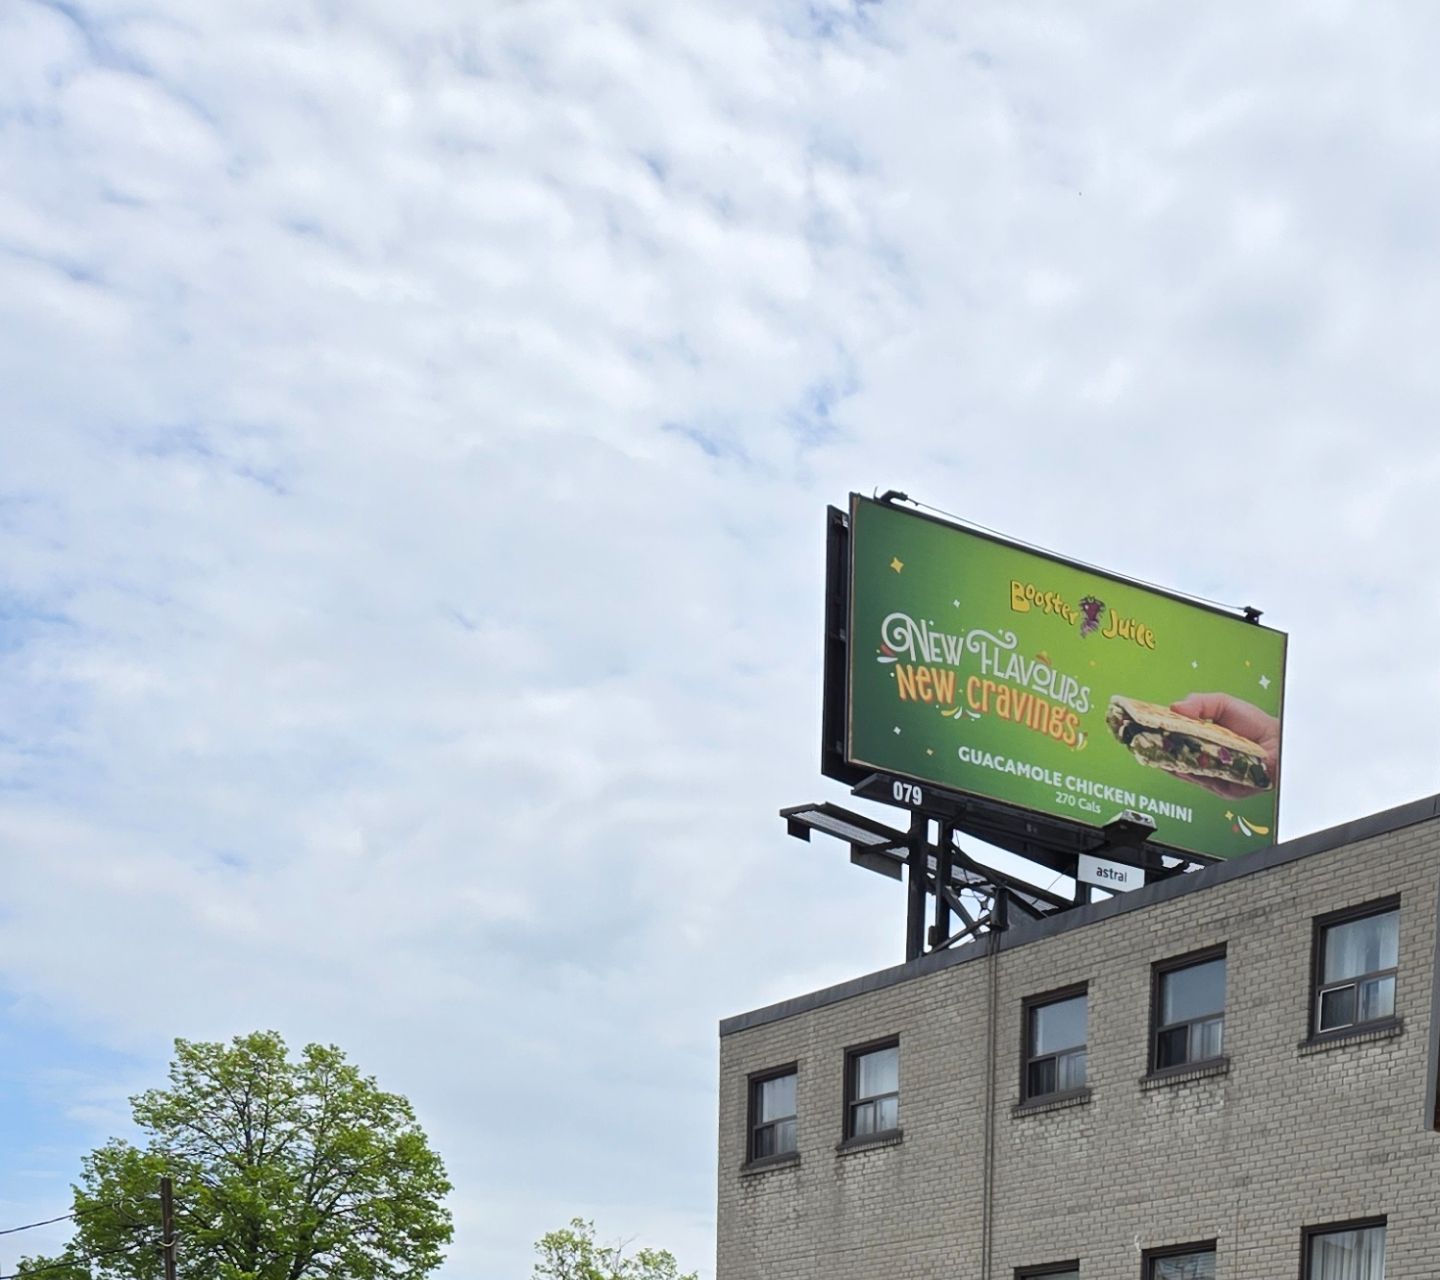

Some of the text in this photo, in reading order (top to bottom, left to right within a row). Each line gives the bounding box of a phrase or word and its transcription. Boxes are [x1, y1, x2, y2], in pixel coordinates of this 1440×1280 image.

[1011, 580, 1156, 649] Booster Juice
[966, 675, 1080, 747] cravings
[893, 781, 922, 806] 079
[958, 746, 1193, 824] GUACAMOLE CHICKEN PANINI
[1055, 791, 1101, 815] 270 Cals
[1096, 865, 1128, 883] astral
